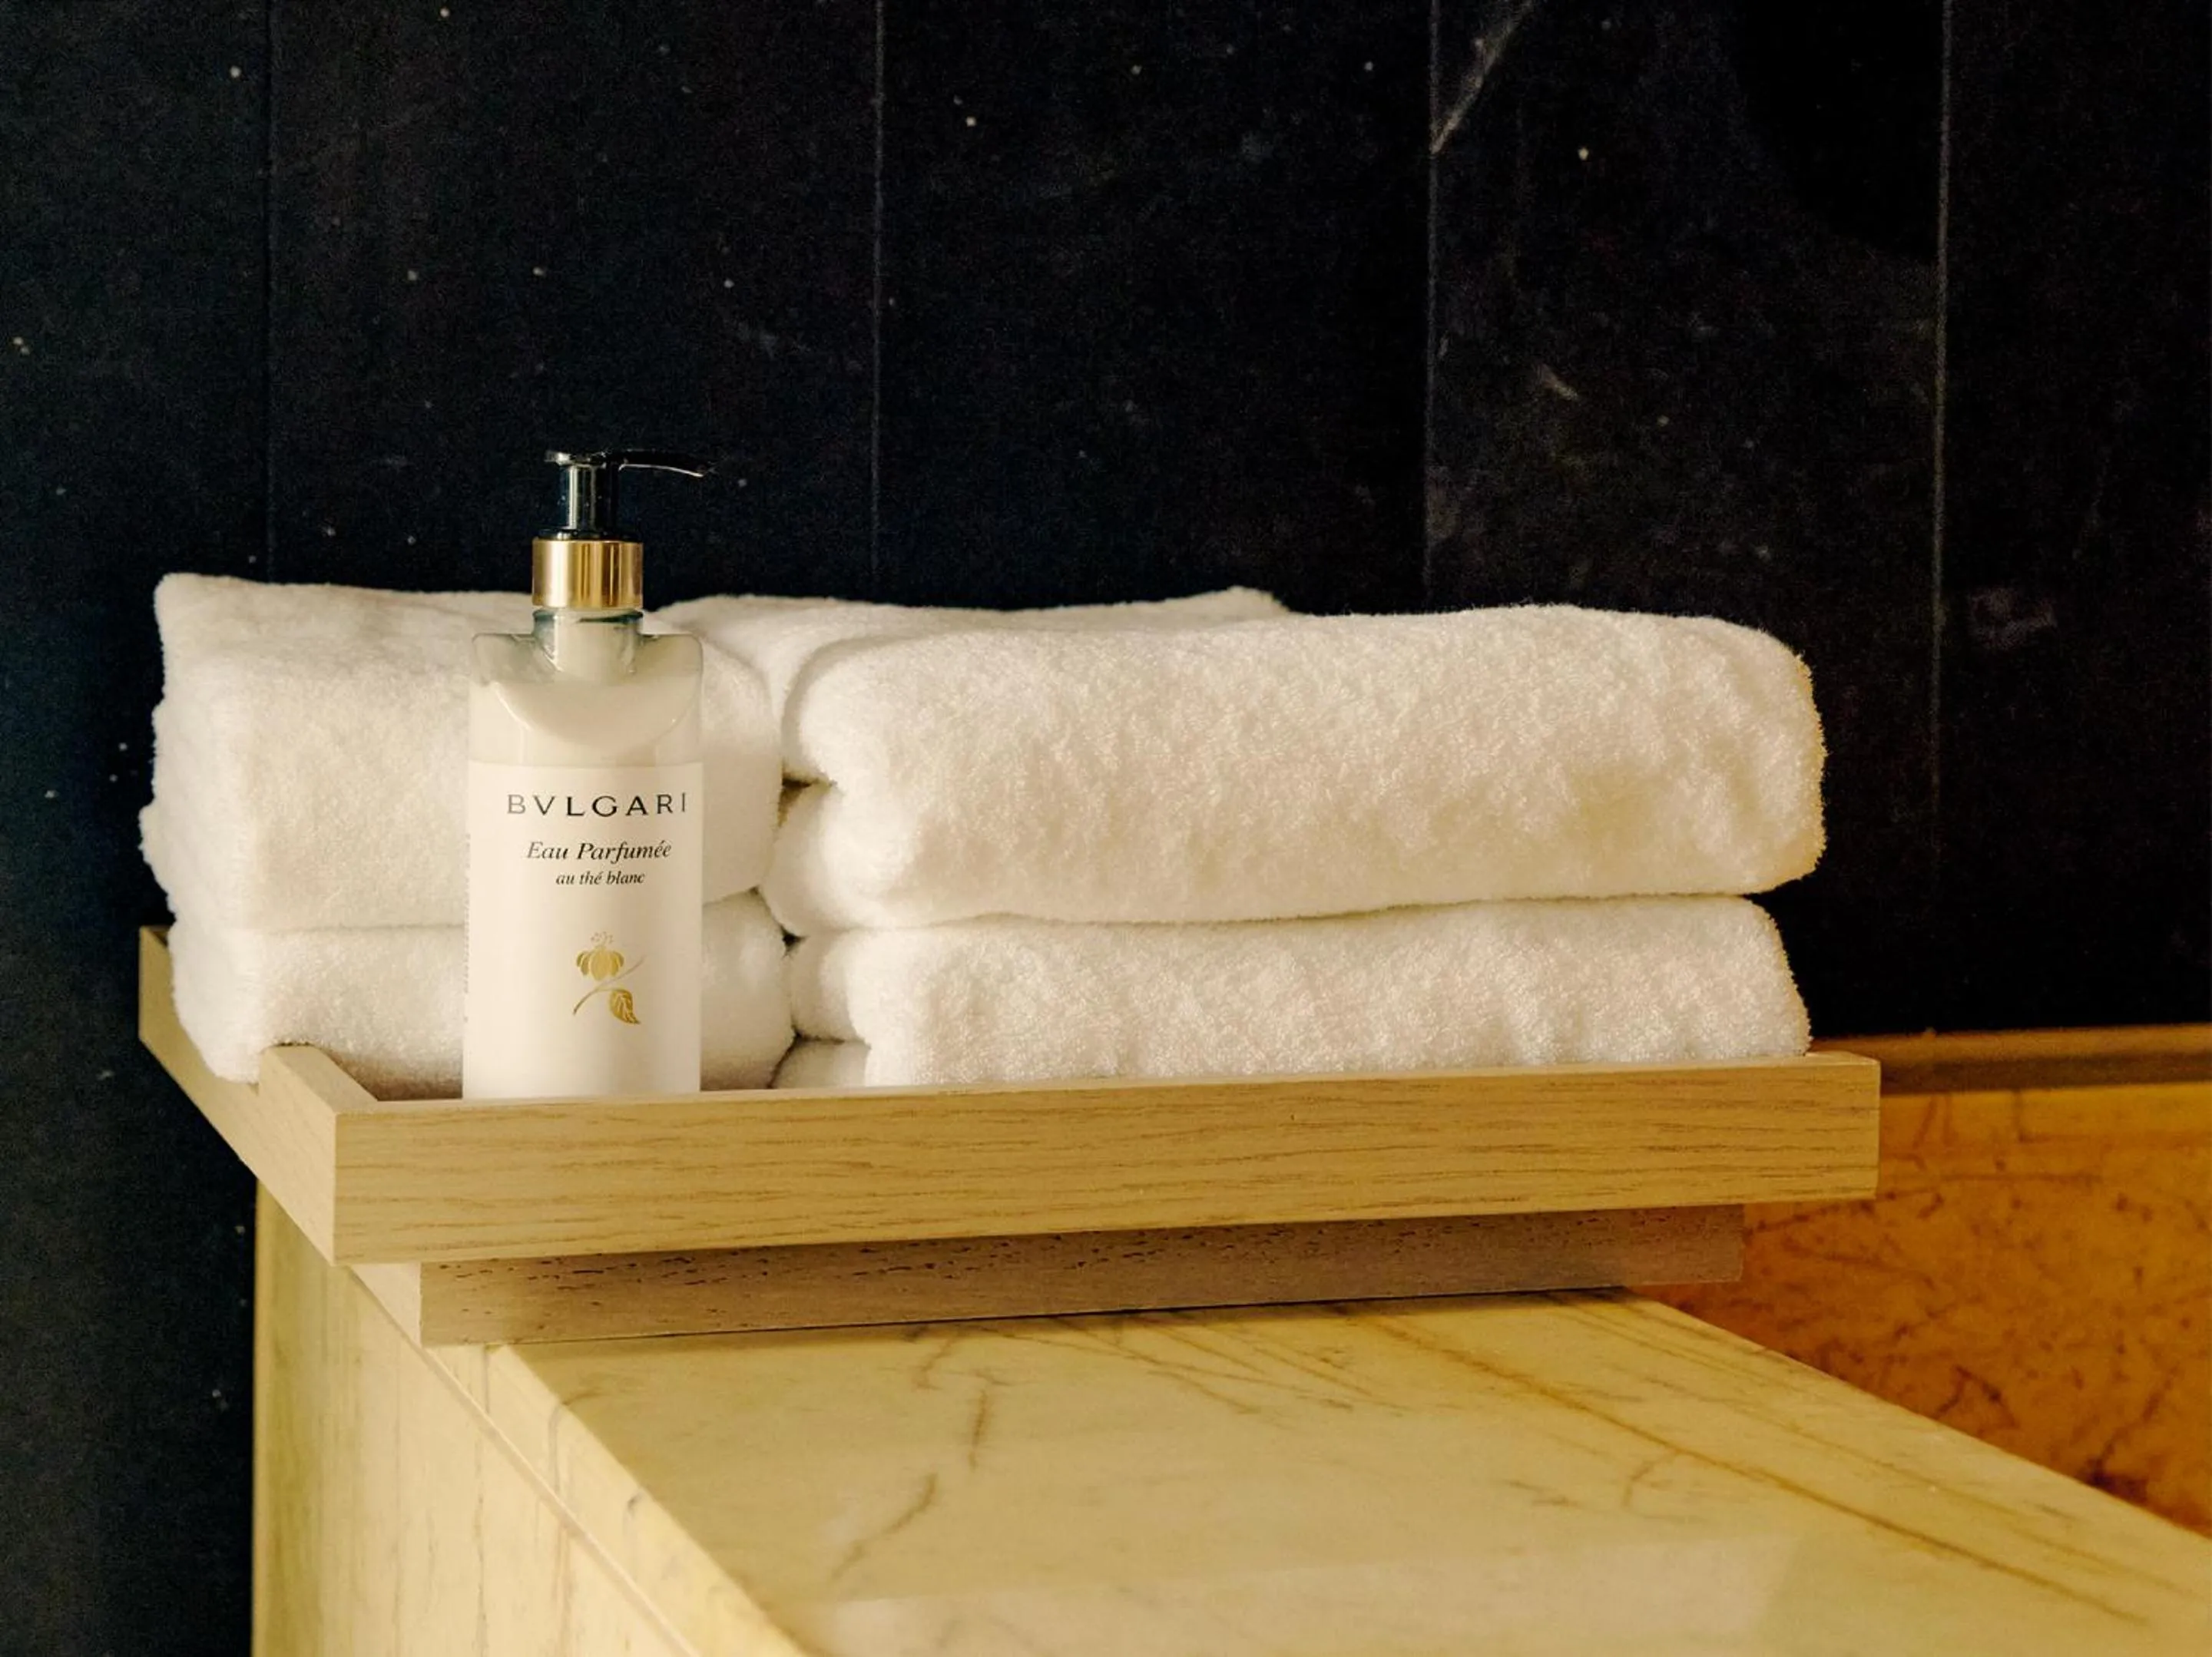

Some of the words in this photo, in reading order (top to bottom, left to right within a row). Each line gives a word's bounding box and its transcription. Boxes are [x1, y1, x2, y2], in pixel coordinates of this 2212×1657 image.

[507, 792, 686, 817] BVLGARI
[527, 842, 568, 859] Eau
[576, 840, 671, 864] Parfumée
[555, 874, 575, 885] au
[579, 870, 603, 885] thé
[605, 870, 645, 885] blanc
